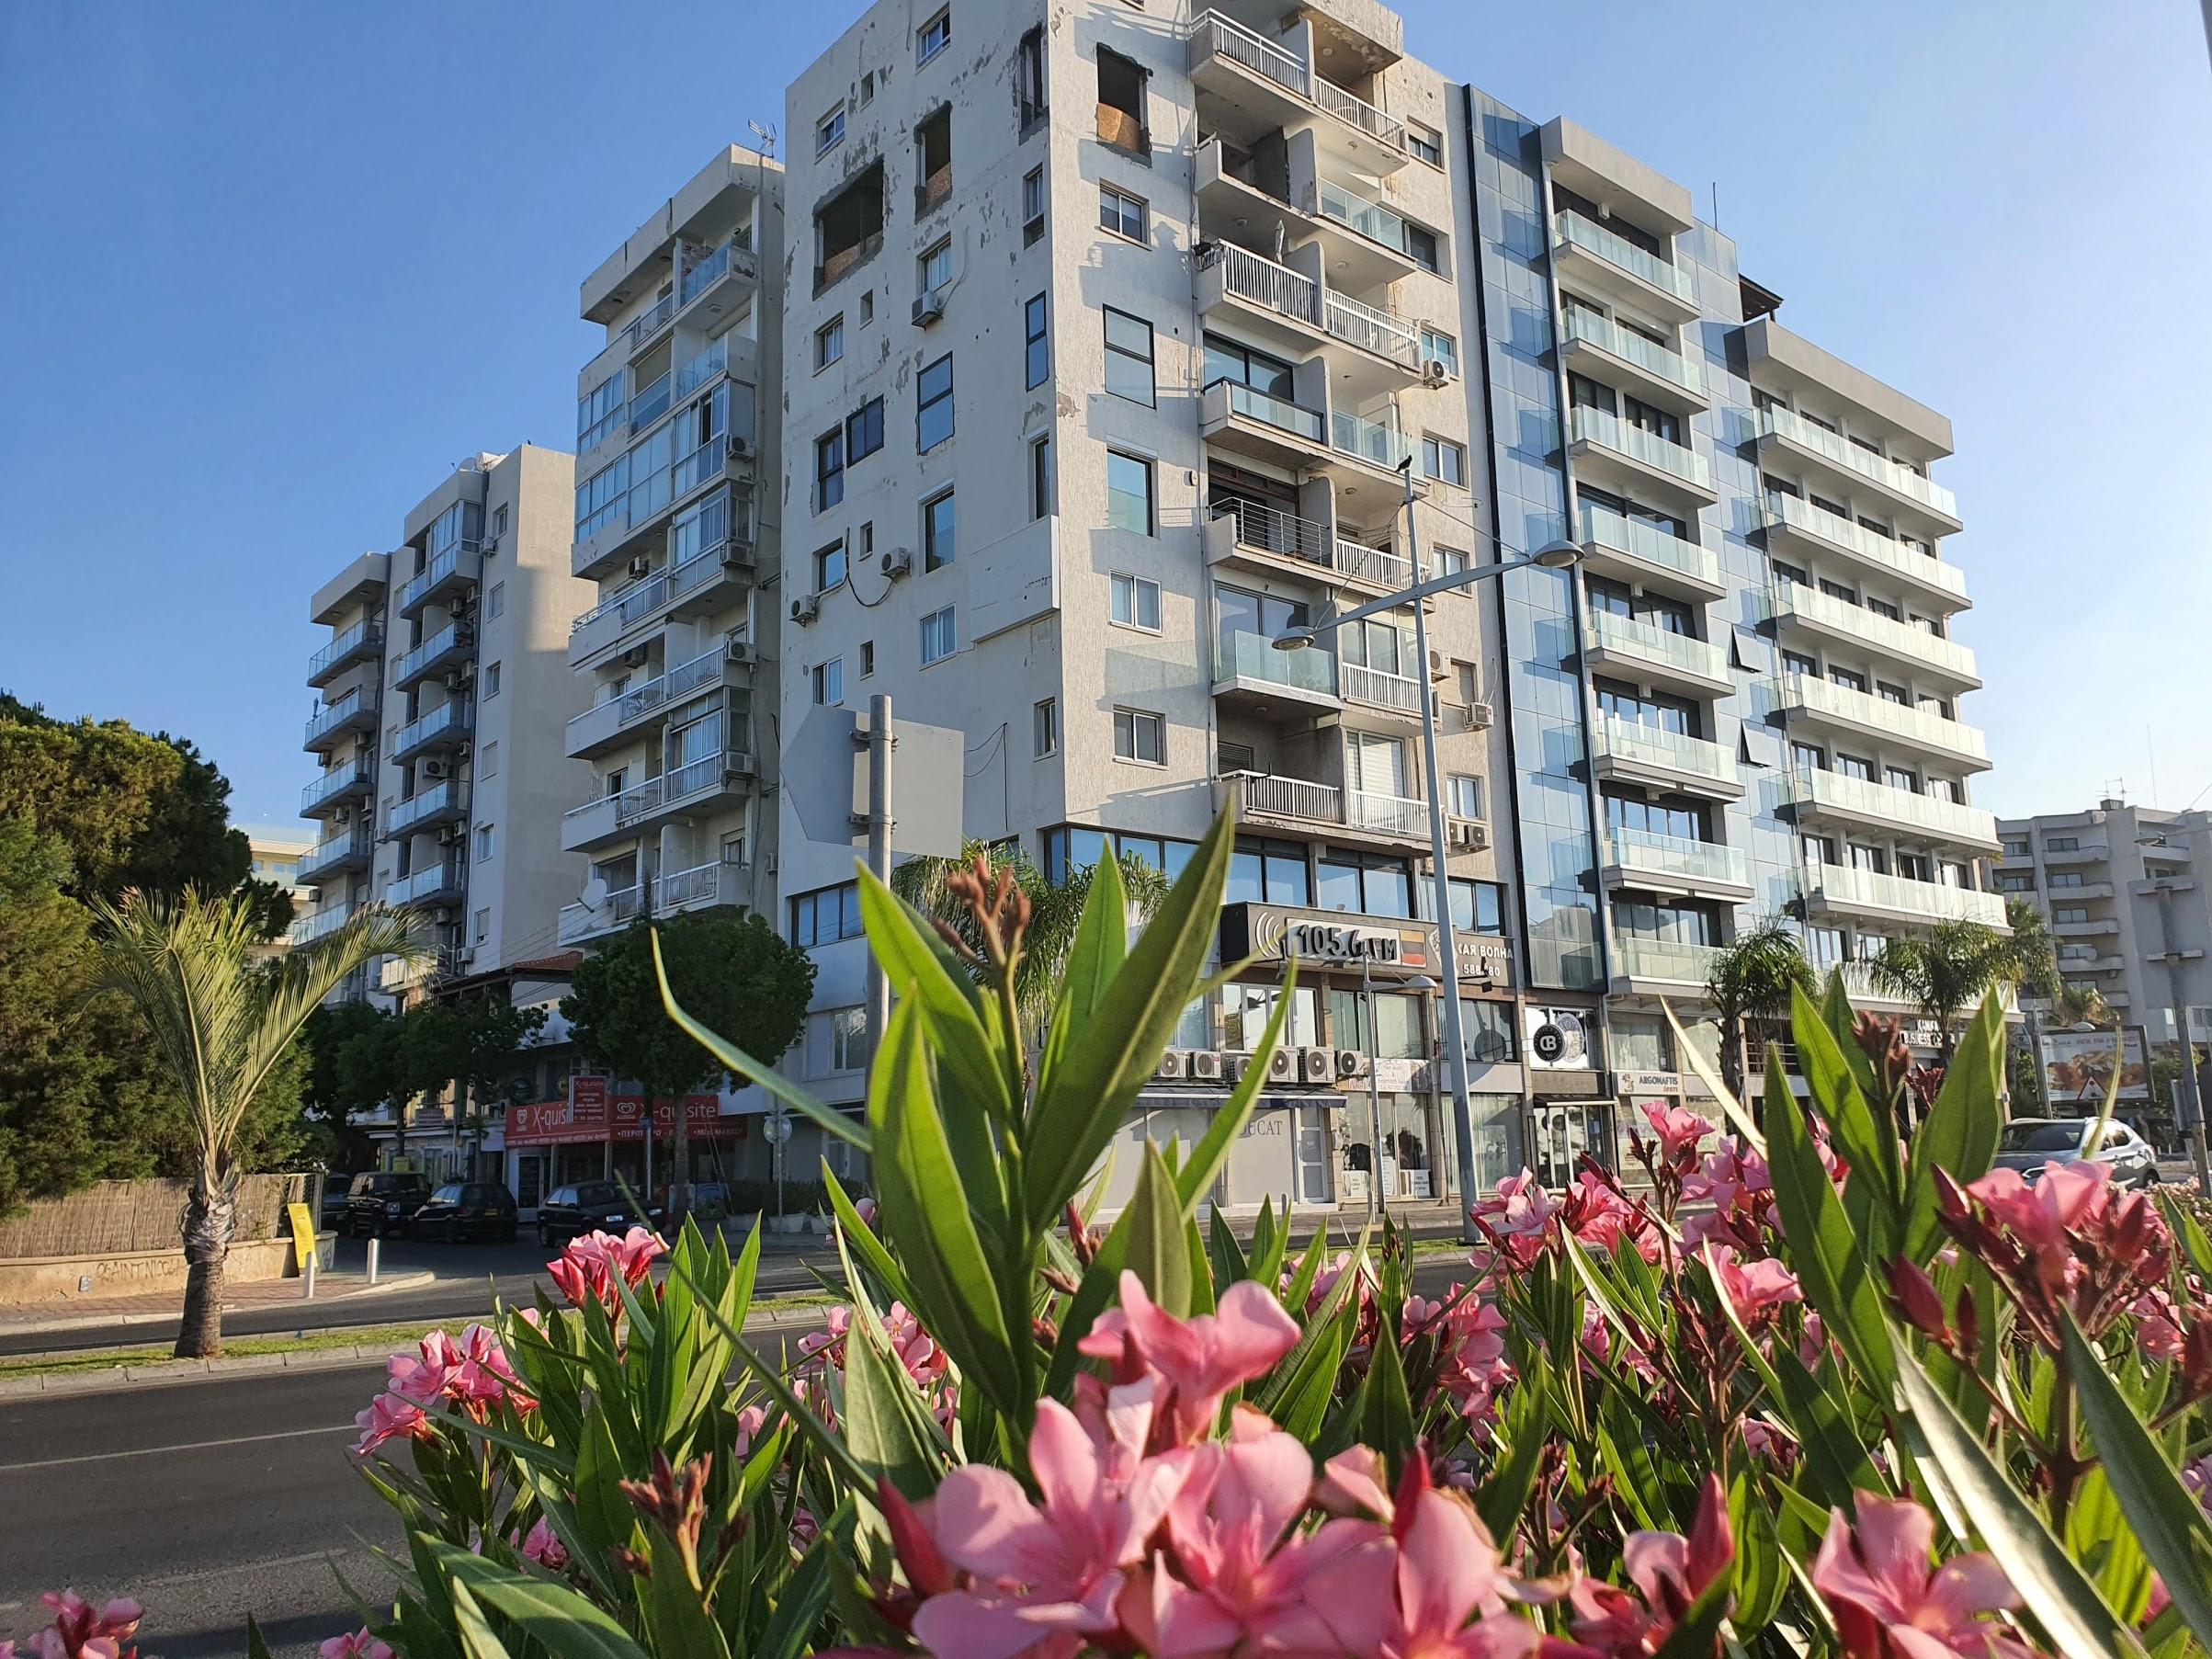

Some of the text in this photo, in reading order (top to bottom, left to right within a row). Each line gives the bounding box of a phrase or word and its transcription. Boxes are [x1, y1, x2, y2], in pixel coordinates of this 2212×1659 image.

[1298, 924, 1364, 958] 105.6
[1480, 945, 1514, 959] ВОЛНА
[1901, 1032, 1931, 1045] BUSINESS
[1639, 1075, 1678, 1085] ARGONAFTIS
[533, 1103, 569, 1135] X-quisi
[640, 1102, 715, 1124] -qsite
